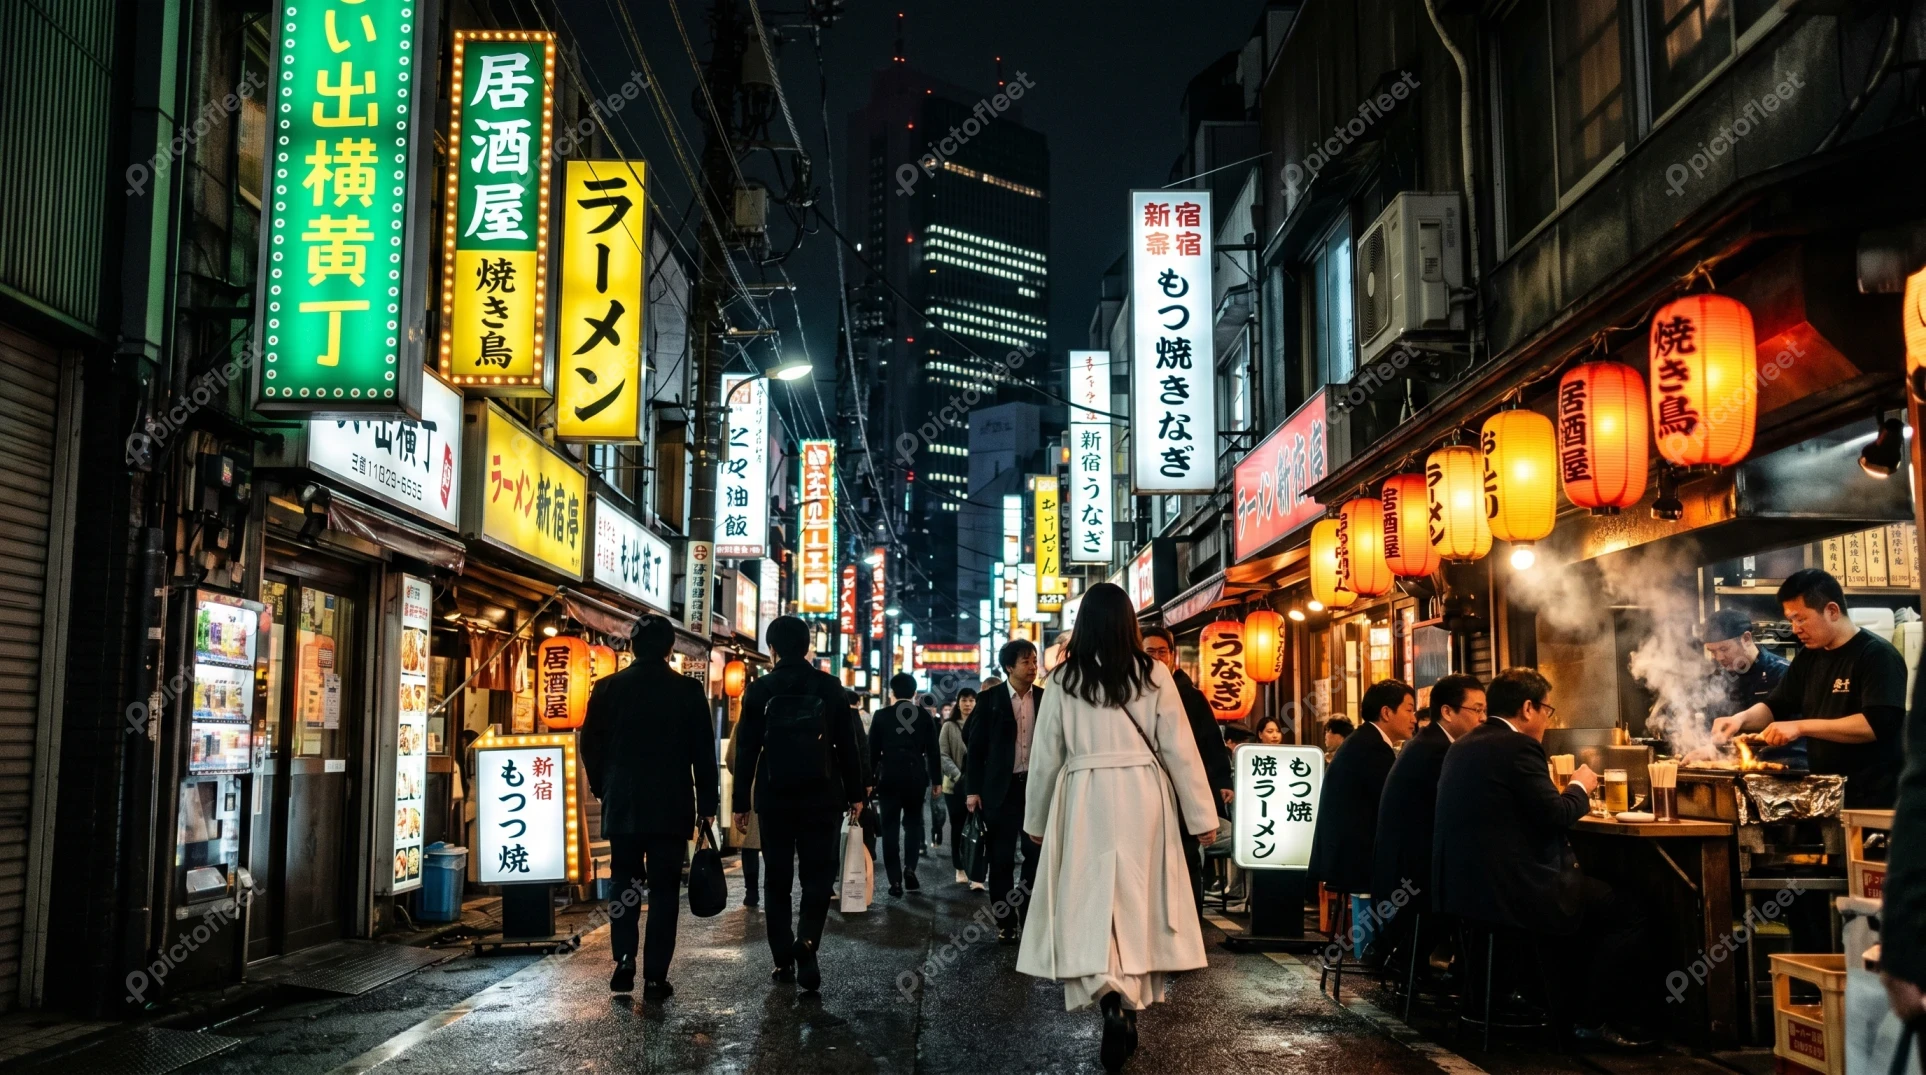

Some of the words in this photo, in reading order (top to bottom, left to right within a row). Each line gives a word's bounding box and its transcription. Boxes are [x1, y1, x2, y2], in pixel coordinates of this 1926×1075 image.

[299, 0, 379, 367] い出横黄丁
[464, 52, 534, 242] 居酒屋
[1144, 201, 1201, 227] 新宿
[475, 257, 516, 369] 焼き鳥
[572, 177, 634, 422] ラーメン
[1155, 268, 1194, 477] もつ焼きなぎ
[1653, 315, 1699, 438] 焼き鳥
[1561, 380, 1592, 483] 居酒屋
[1080, 430, 1104, 553] 新宿うなぎ
[1427, 463, 1445, 546] ラーメン
[543, 645, 570, 719] 居酒屋
[498, 758, 530, 874] もつつ焼
[532, 756, 555, 801] 新宿
[1251, 756, 1276, 859] 焼ラーメン
[1286, 757, 1313, 823] もつ焼
